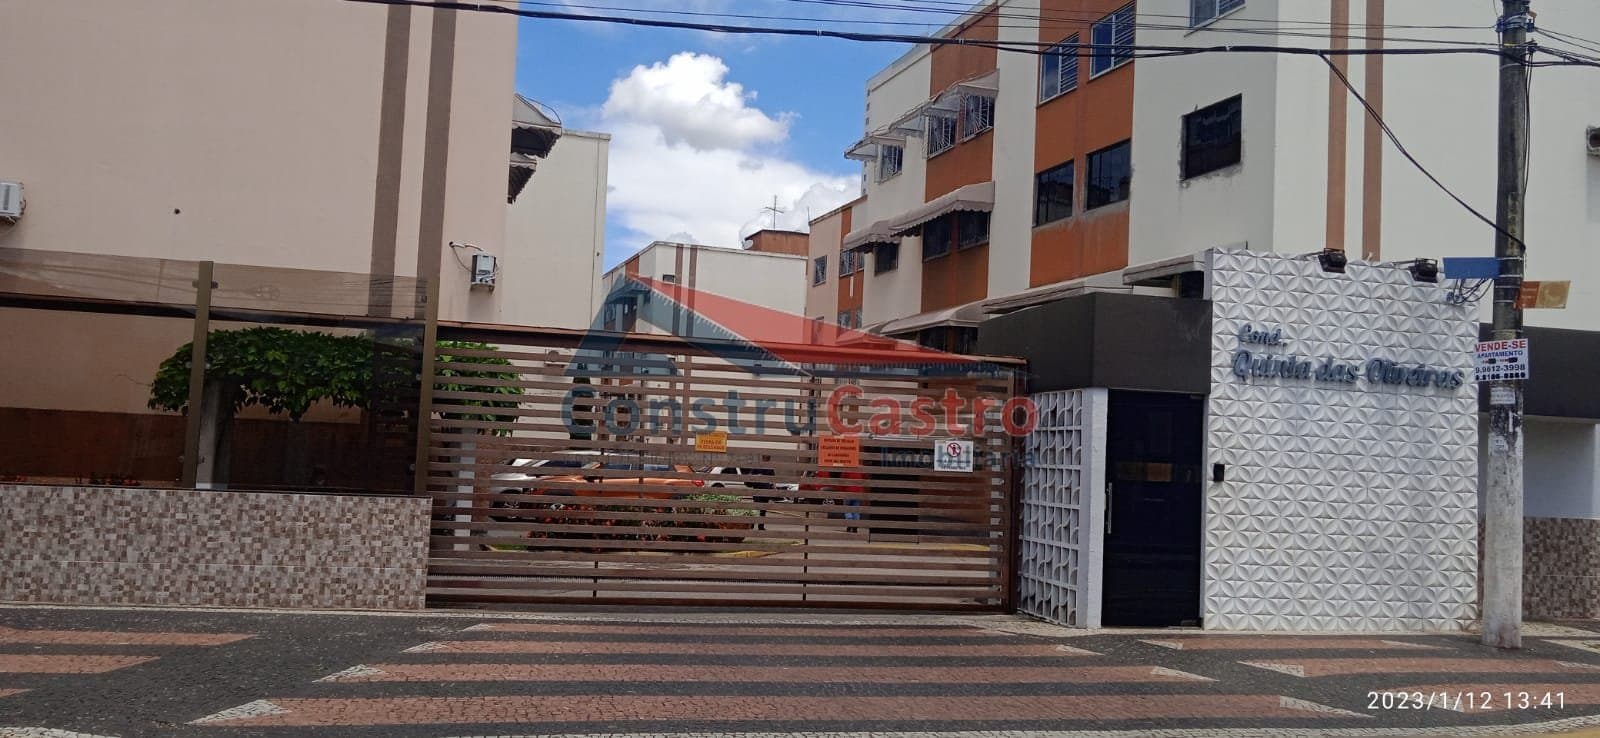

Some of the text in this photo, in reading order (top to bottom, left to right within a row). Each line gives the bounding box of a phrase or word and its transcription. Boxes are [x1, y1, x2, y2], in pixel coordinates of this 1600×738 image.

[1475, 340, 1527, 352] VENDE-SE
[1477, 350, 1524, 359] APARTAMENTO
[1314, 356, 1360, 383] das
